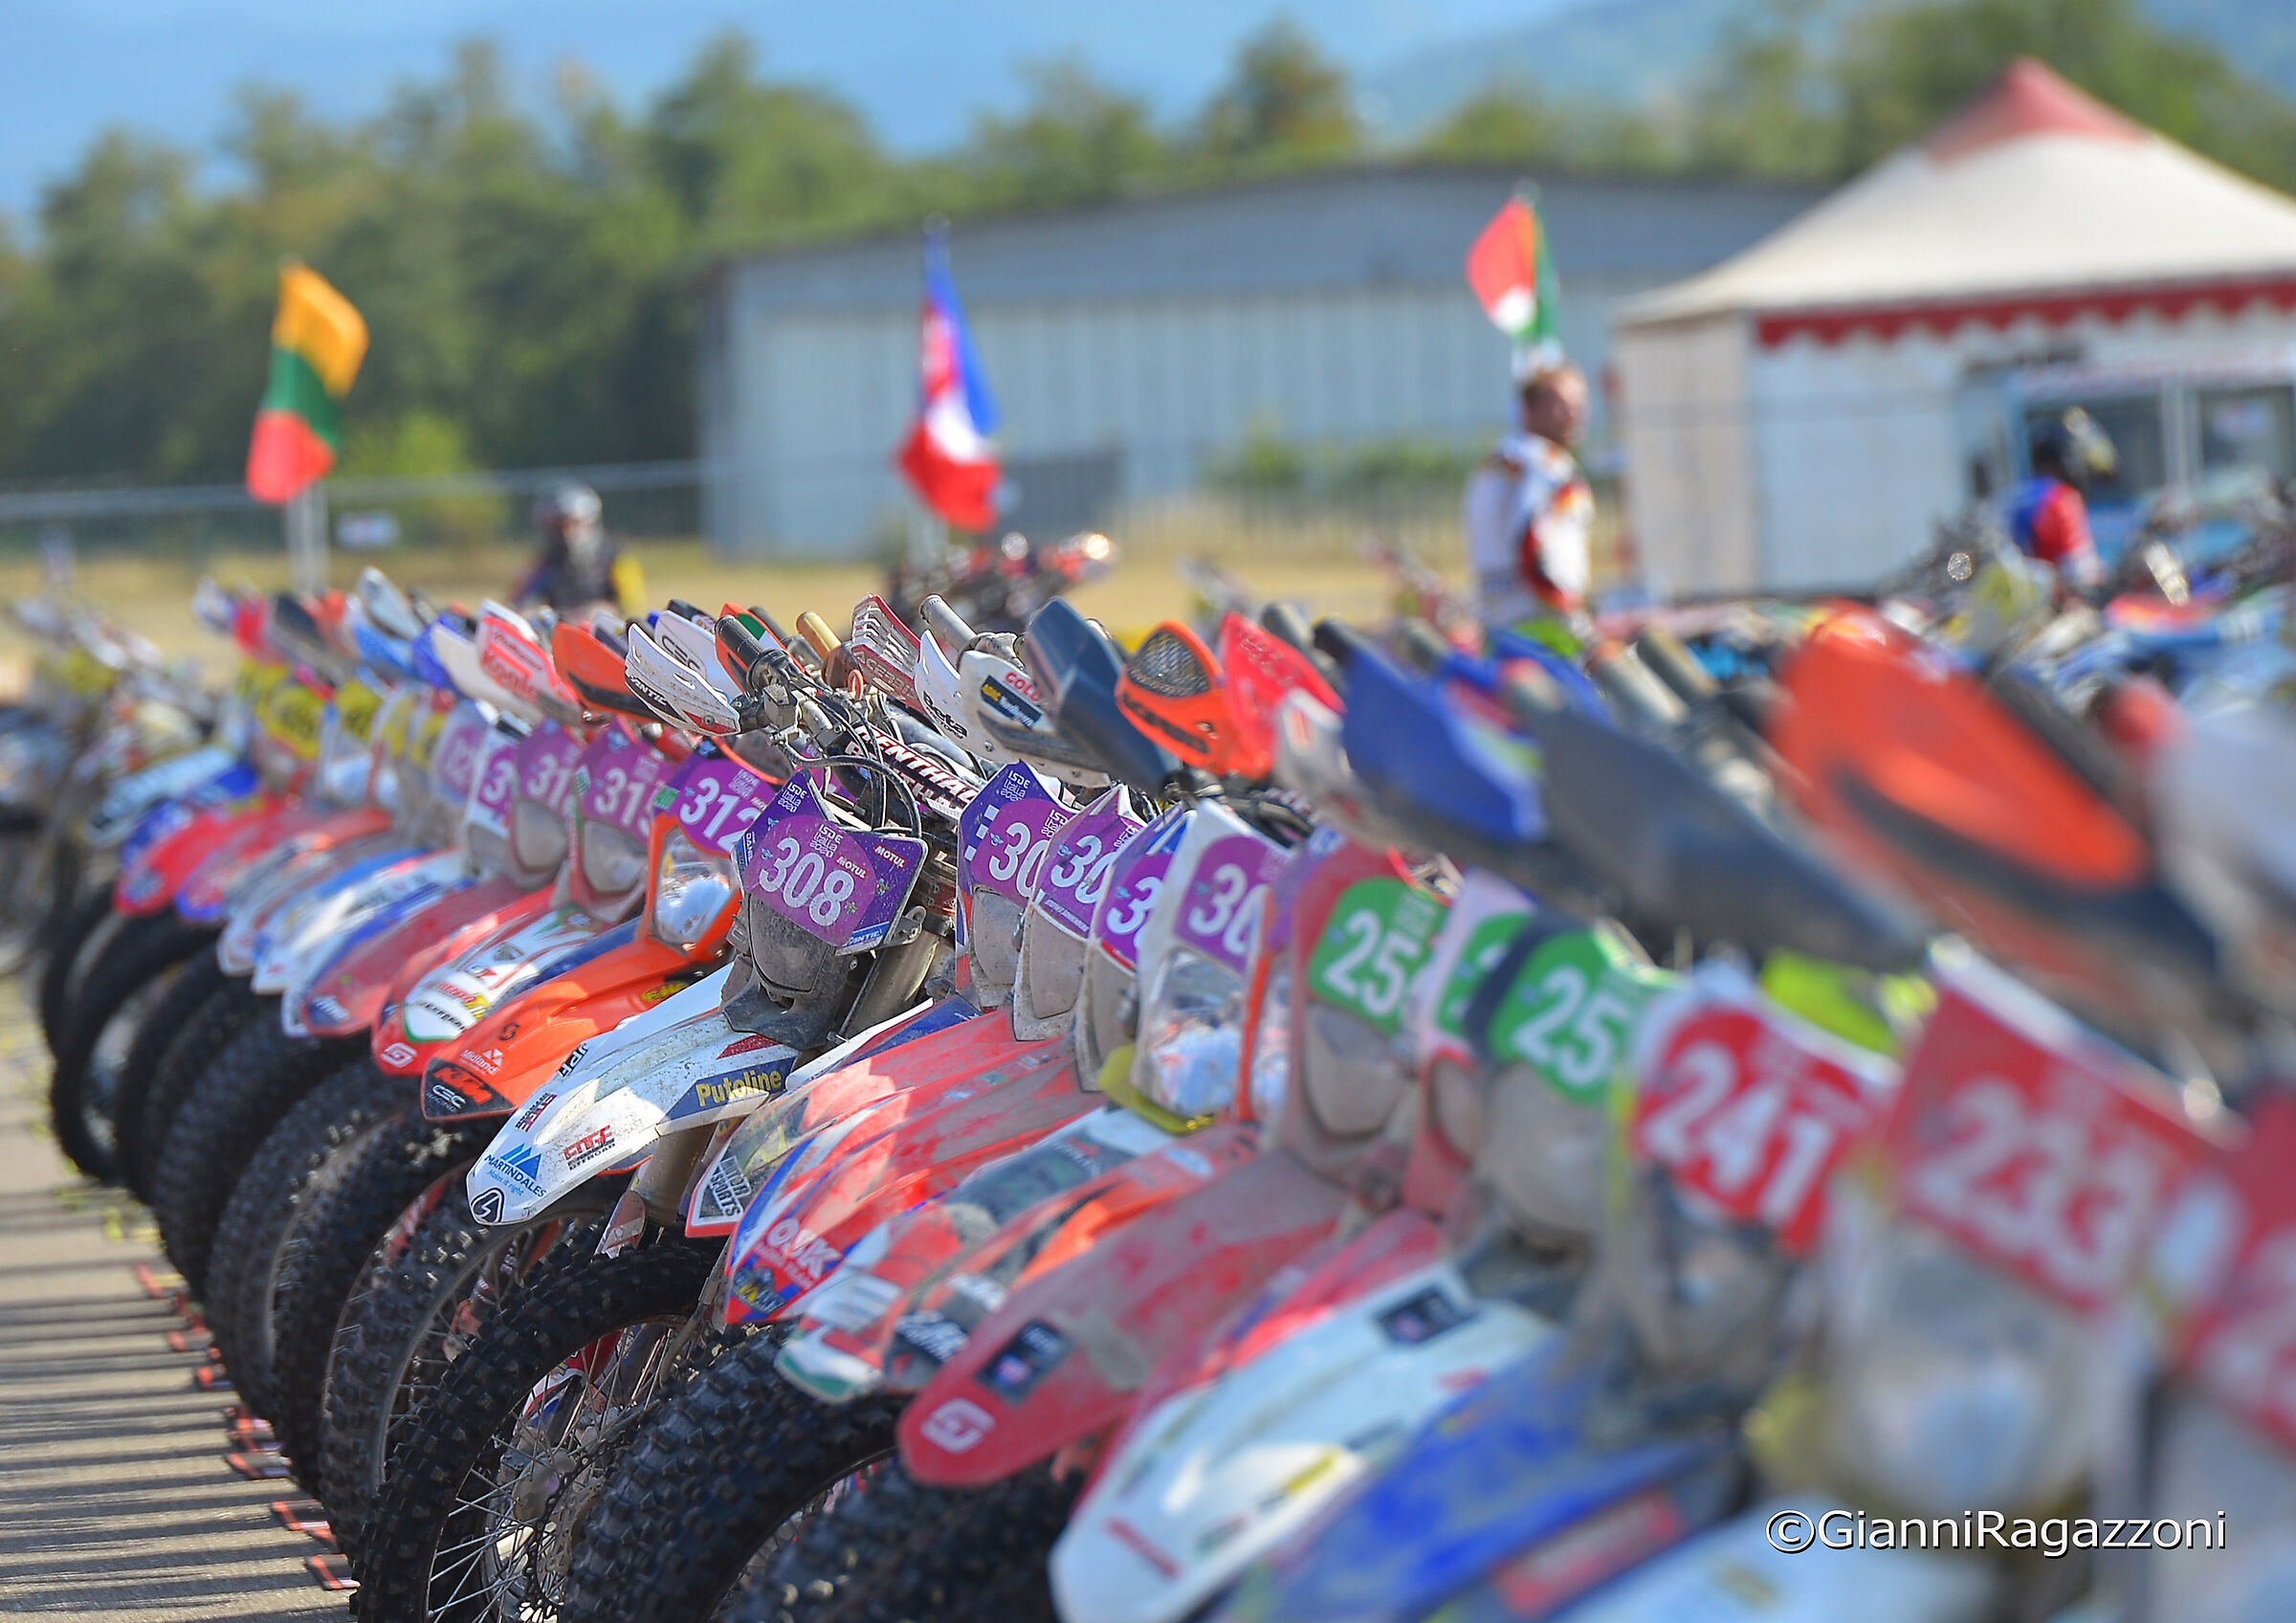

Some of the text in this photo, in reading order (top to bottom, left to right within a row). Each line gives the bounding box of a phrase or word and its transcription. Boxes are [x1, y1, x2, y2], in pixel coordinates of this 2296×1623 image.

[760, 836, 855, 927] 308
[836, 856, 868, 879] MOTUL
[874, 845, 906, 868] MOTUL
[989, 822, 1049, 898] 30
[1050, 835, 1114, 904] 30
[1188, 863, 1269, 955] 30
[1324, 908, 1419, 1016] 25
[1512, 966, 1627, 1086] 25
[695, 1068, 783, 1107] Putoline
[1646, 1041, 1835, 1223] 241
[484, 1154, 547, 1198] MARTINDALES
[711, 1172, 741, 1216] SPORTS
[1913, 1079, 2160, 1301] 233
